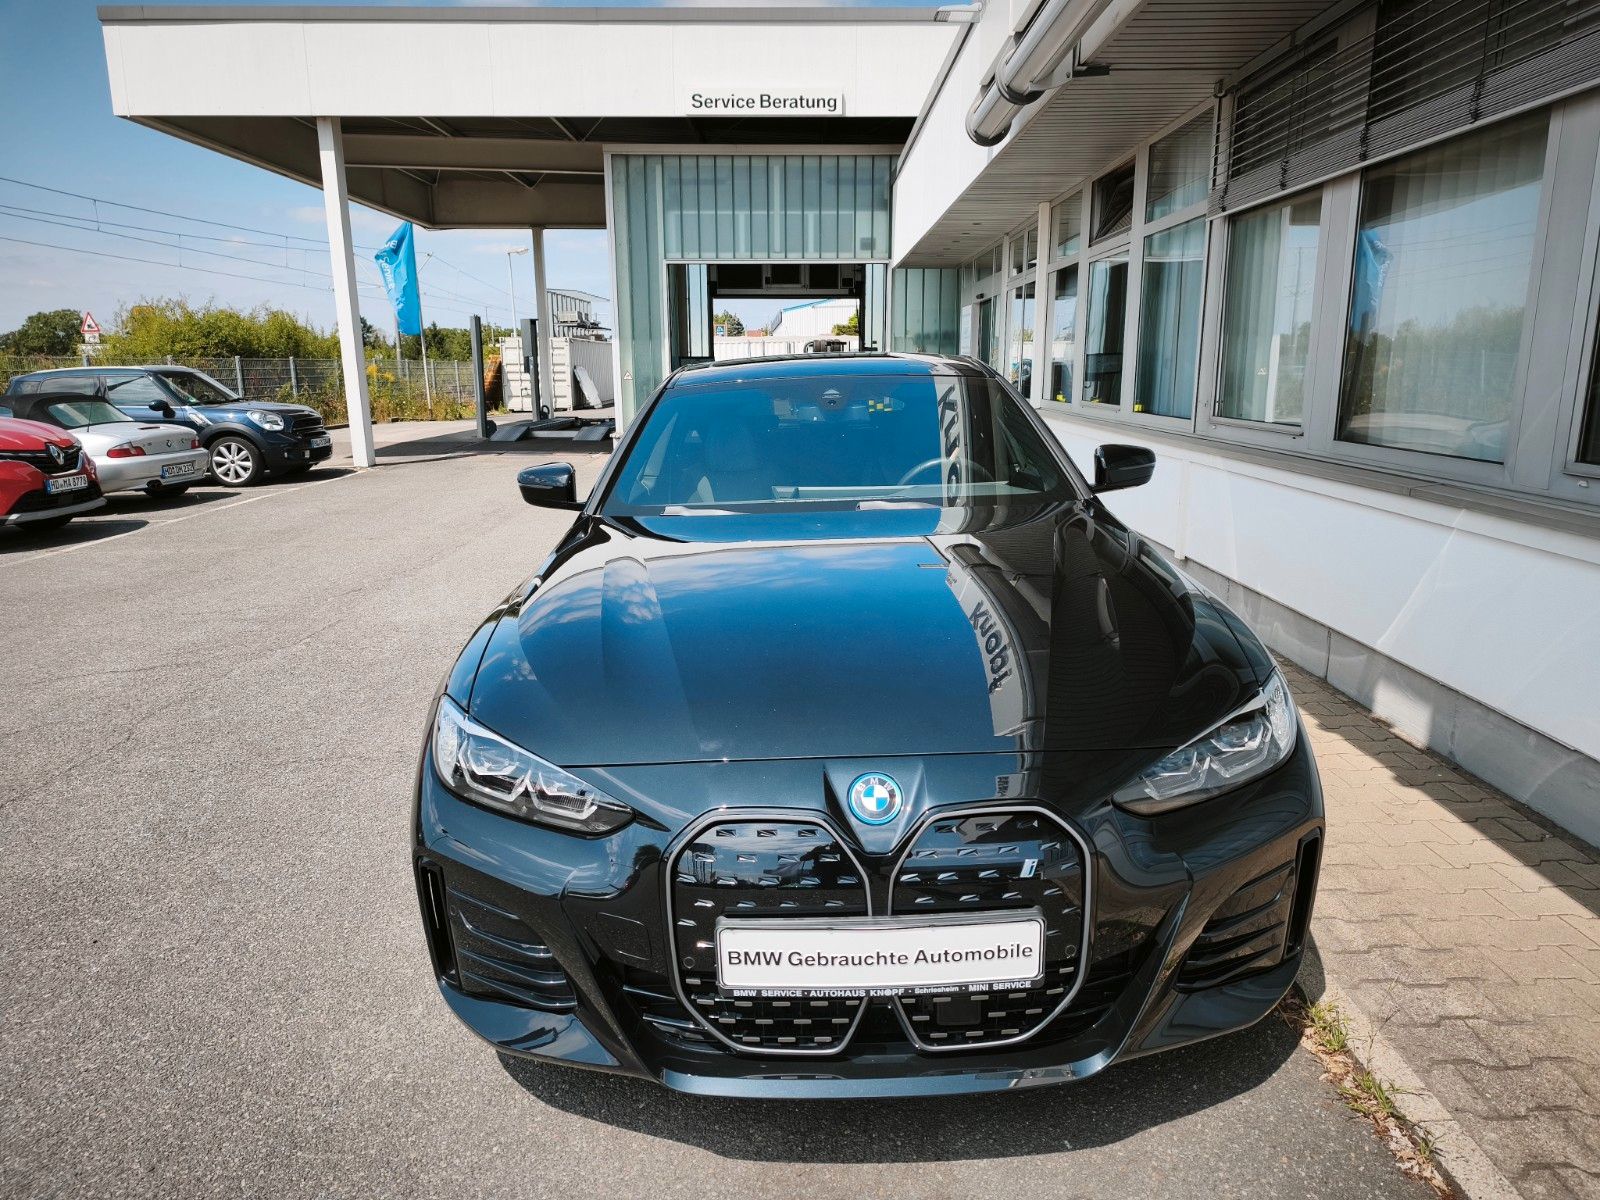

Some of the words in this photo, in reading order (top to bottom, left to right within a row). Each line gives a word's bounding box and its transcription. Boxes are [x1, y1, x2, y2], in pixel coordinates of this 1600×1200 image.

[691, 93, 755, 109] Service
[760, 94, 837, 112] Beratung
[856, 777, 894, 792] BMW
[728, 951, 783, 966] BMW
[788, 951, 909, 966] Gebrauchte
[914, 944, 1033, 964] Automobile
[733, 989, 757, 997] BMW
[761, 989, 803, 997] SERVICE
[809, 989, 866, 997] AUTOHAUS
[869, 988, 905, 997] KNOPF
[968, 984, 989, 992] MINI
[992, 981, 1032, 990] SERVICE
